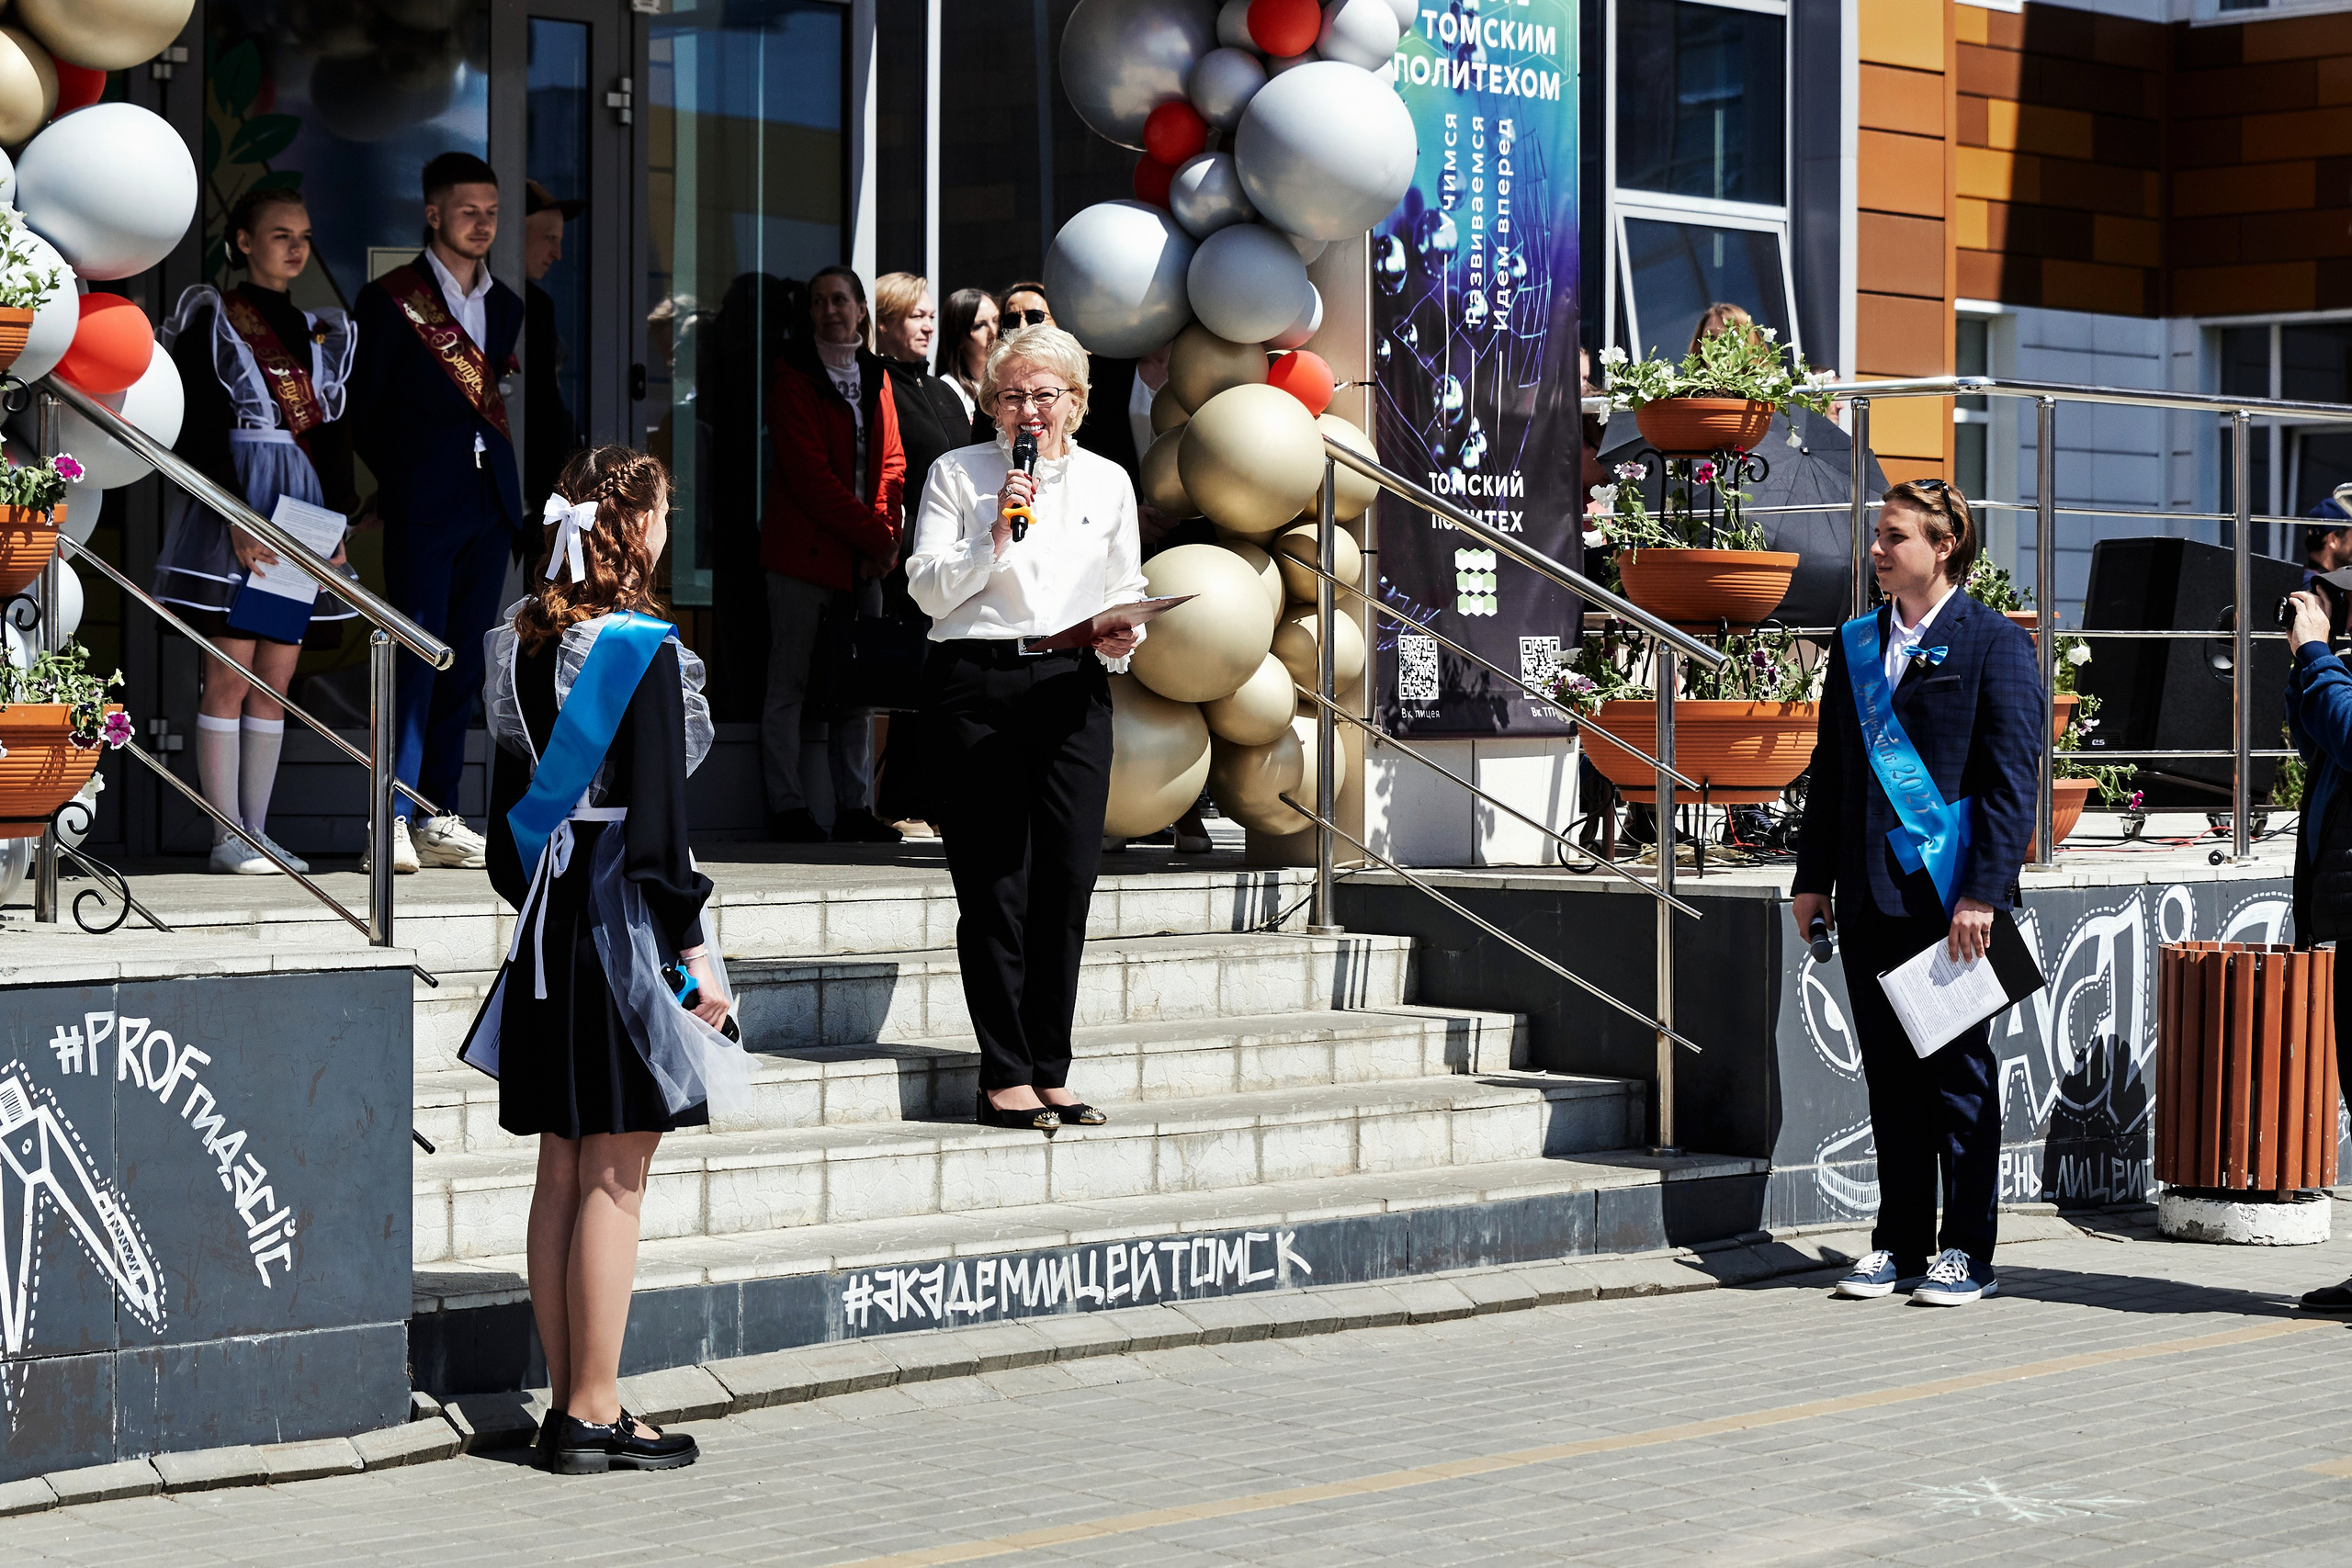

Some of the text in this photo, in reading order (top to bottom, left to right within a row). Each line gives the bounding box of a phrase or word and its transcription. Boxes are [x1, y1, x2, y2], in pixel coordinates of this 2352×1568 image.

[1421, 9, 1556, 56] ТОМСКИМ
[1394, 51, 1560, 101] ПОЛИТЕХОМ
[1440, 113, 1458, 231] Учимся
[1465, 117, 1485, 325] Развиваемся
[1493, 118, 1514, 331] Идем вперед
[1429, 469, 1524, 498] ТОМСКИЙ
